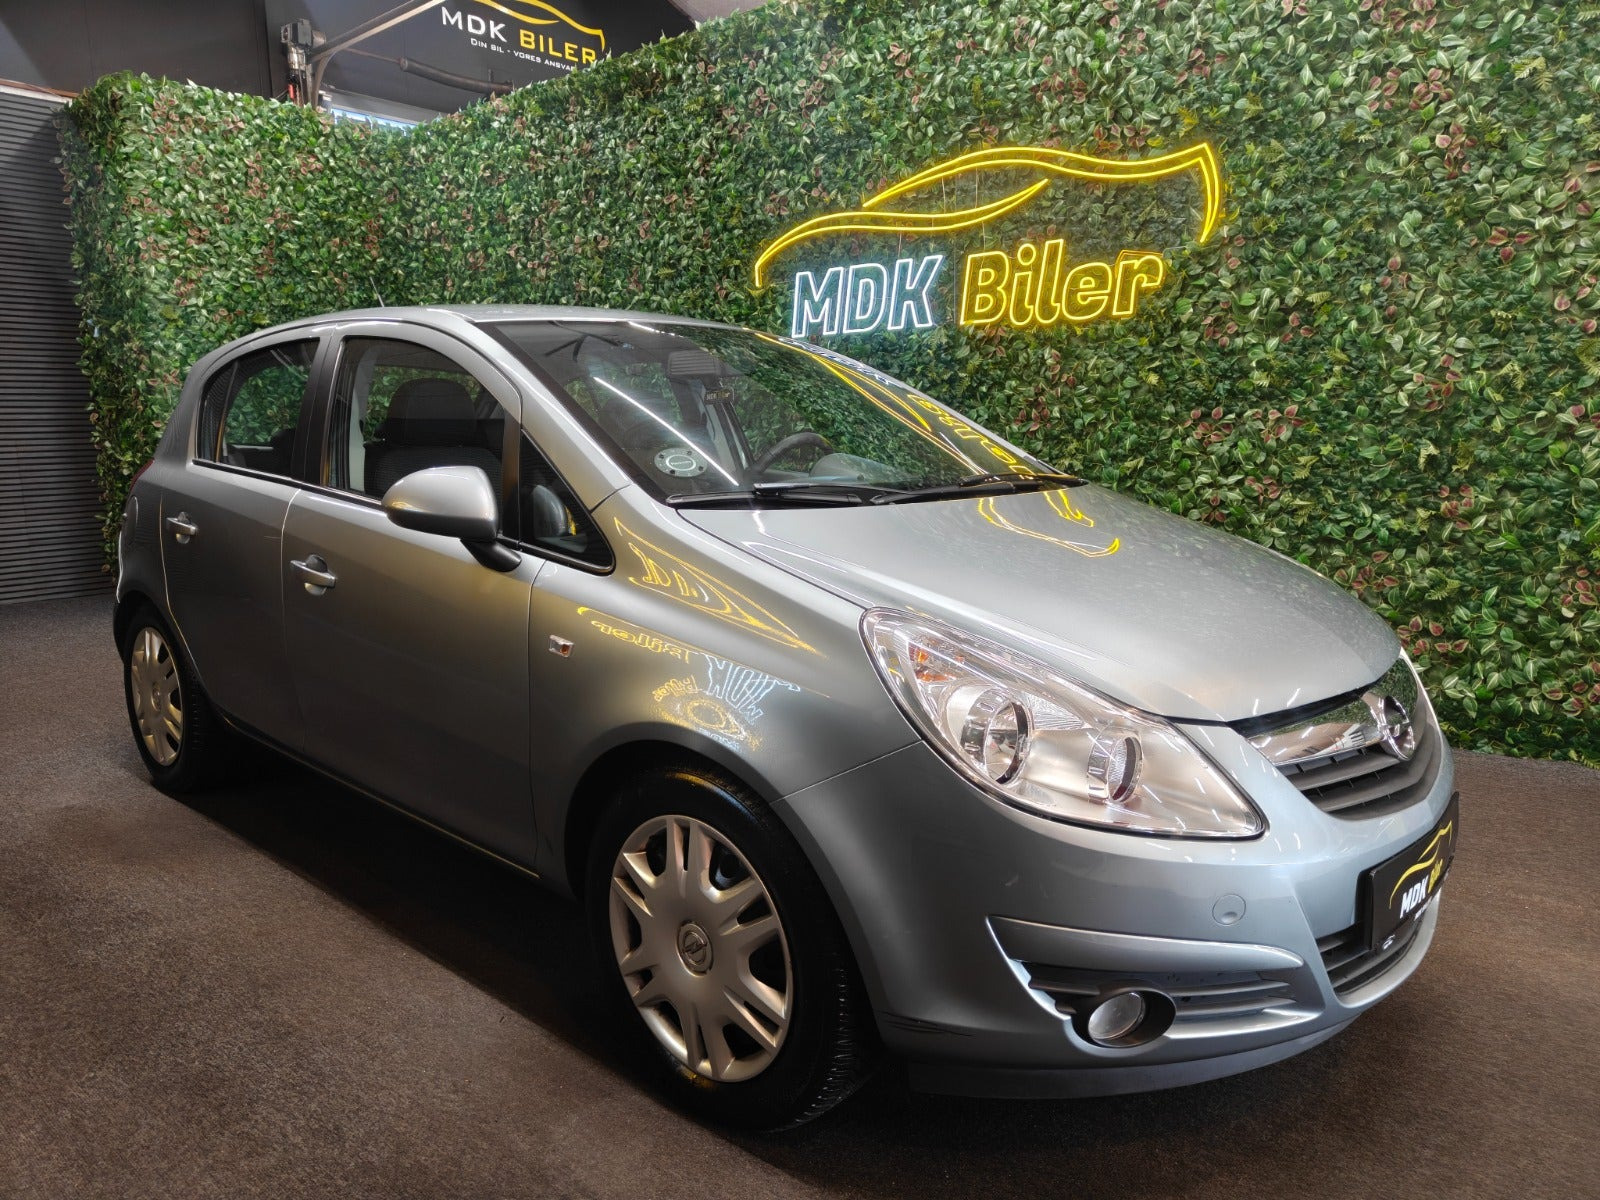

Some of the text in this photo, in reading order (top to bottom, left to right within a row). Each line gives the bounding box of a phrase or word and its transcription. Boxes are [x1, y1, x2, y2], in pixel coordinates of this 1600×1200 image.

[441, 6, 597, 65] MDK BILER
[470, 37, 488, 49] DIN
[490, 44, 505, 54] BIL
[513, 50, 542, 63] VORES
[792, 238, 1167, 339] MDK Biler
[1400, 874, 1429, 919] MDK
